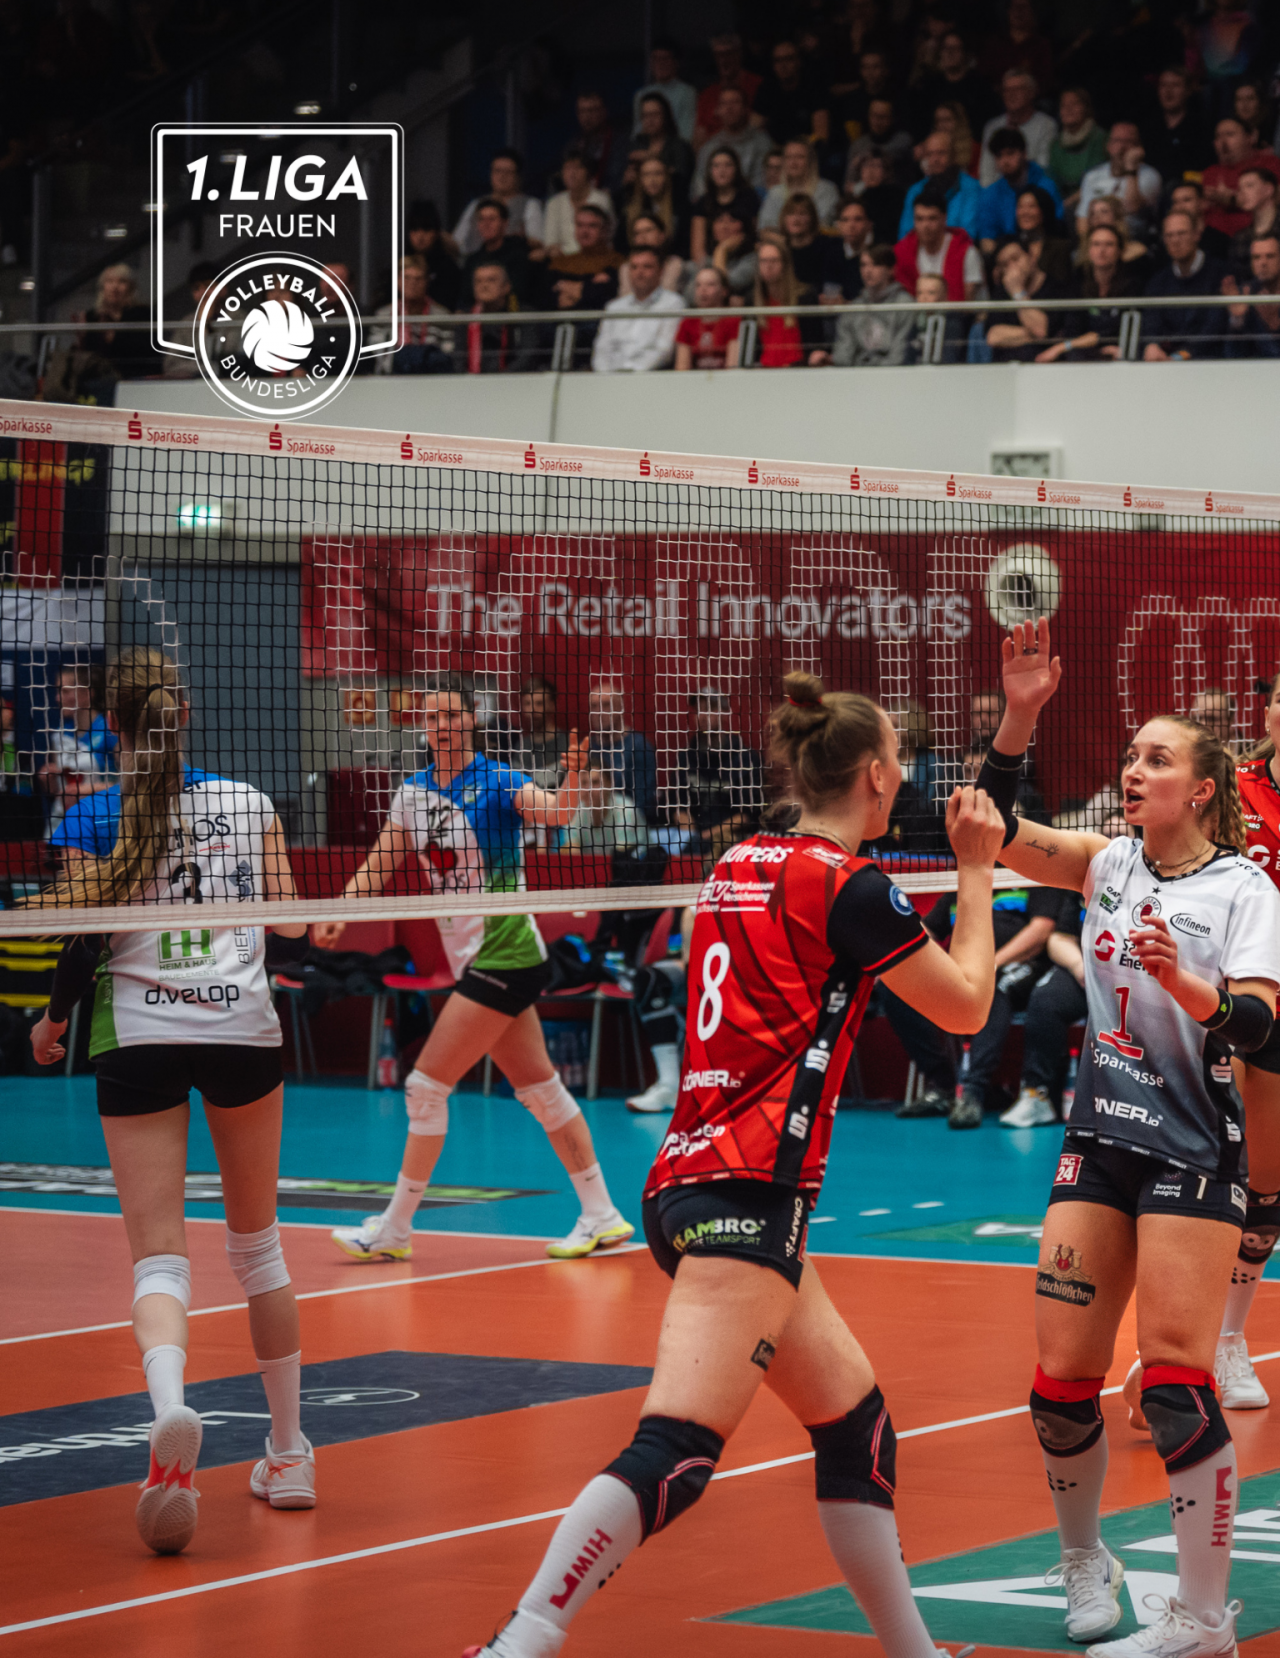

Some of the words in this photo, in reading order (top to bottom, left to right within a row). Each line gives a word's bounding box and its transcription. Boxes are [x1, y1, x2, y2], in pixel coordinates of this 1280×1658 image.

[146, 426, 199, 445] Sparkasse
[286, 437, 336, 456] Sparkasse
[417, 447, 463, 465] Sparkasse
[539, 457, 583, 474] Sparkasse
[653, 465, 695, 482] Sparkasse
[761, 472, 800, 488] Sparkasse
[861, 479, 899, 495] Sparkasse
[958, 486, 993, 501] Sparkasse
[1048, 491, 1081, 506] Sparkasse
[1133, 497, 1165, 511] Sparkasse
[1214, 502, 1245, 515] Sparkasse
[427, 585, 522, 638] The
[540, 580, 680, 638] Retail
[698, 583, 971, 640] Innovators
[730, 881, 776, 891] Sparkassen
[722, 892, 771, 903] Versicherung
[1174, 914, 1212, 936] Infineon
[159, 960, 183, 972] HEIM
[184, 960, 191, 969] &
[192, 958, 218, 969] HAUS
[158, 968, 221, 982] BAUELEMENTE
[145, 984, 241, 1008] d.velop
[696, 941, 731, 1042] 8
[1112, 985, 1132, 1042] 1
[1093, 1047, 1164, 1088] Sparkasse
[1060, 1157, 1075, 1166] TAG
[1056, 1165, 1074, 1182] 24
[1152, 1189, 1181, 1198] Imaging
[1155, 1183, 1182, 1192] Beyond
[1196, 1175, 1208, 1200] 1
[787, 1196, 804, 1249] CRAFT
[705, 1234, 761, 1247] TEAMSPORT
